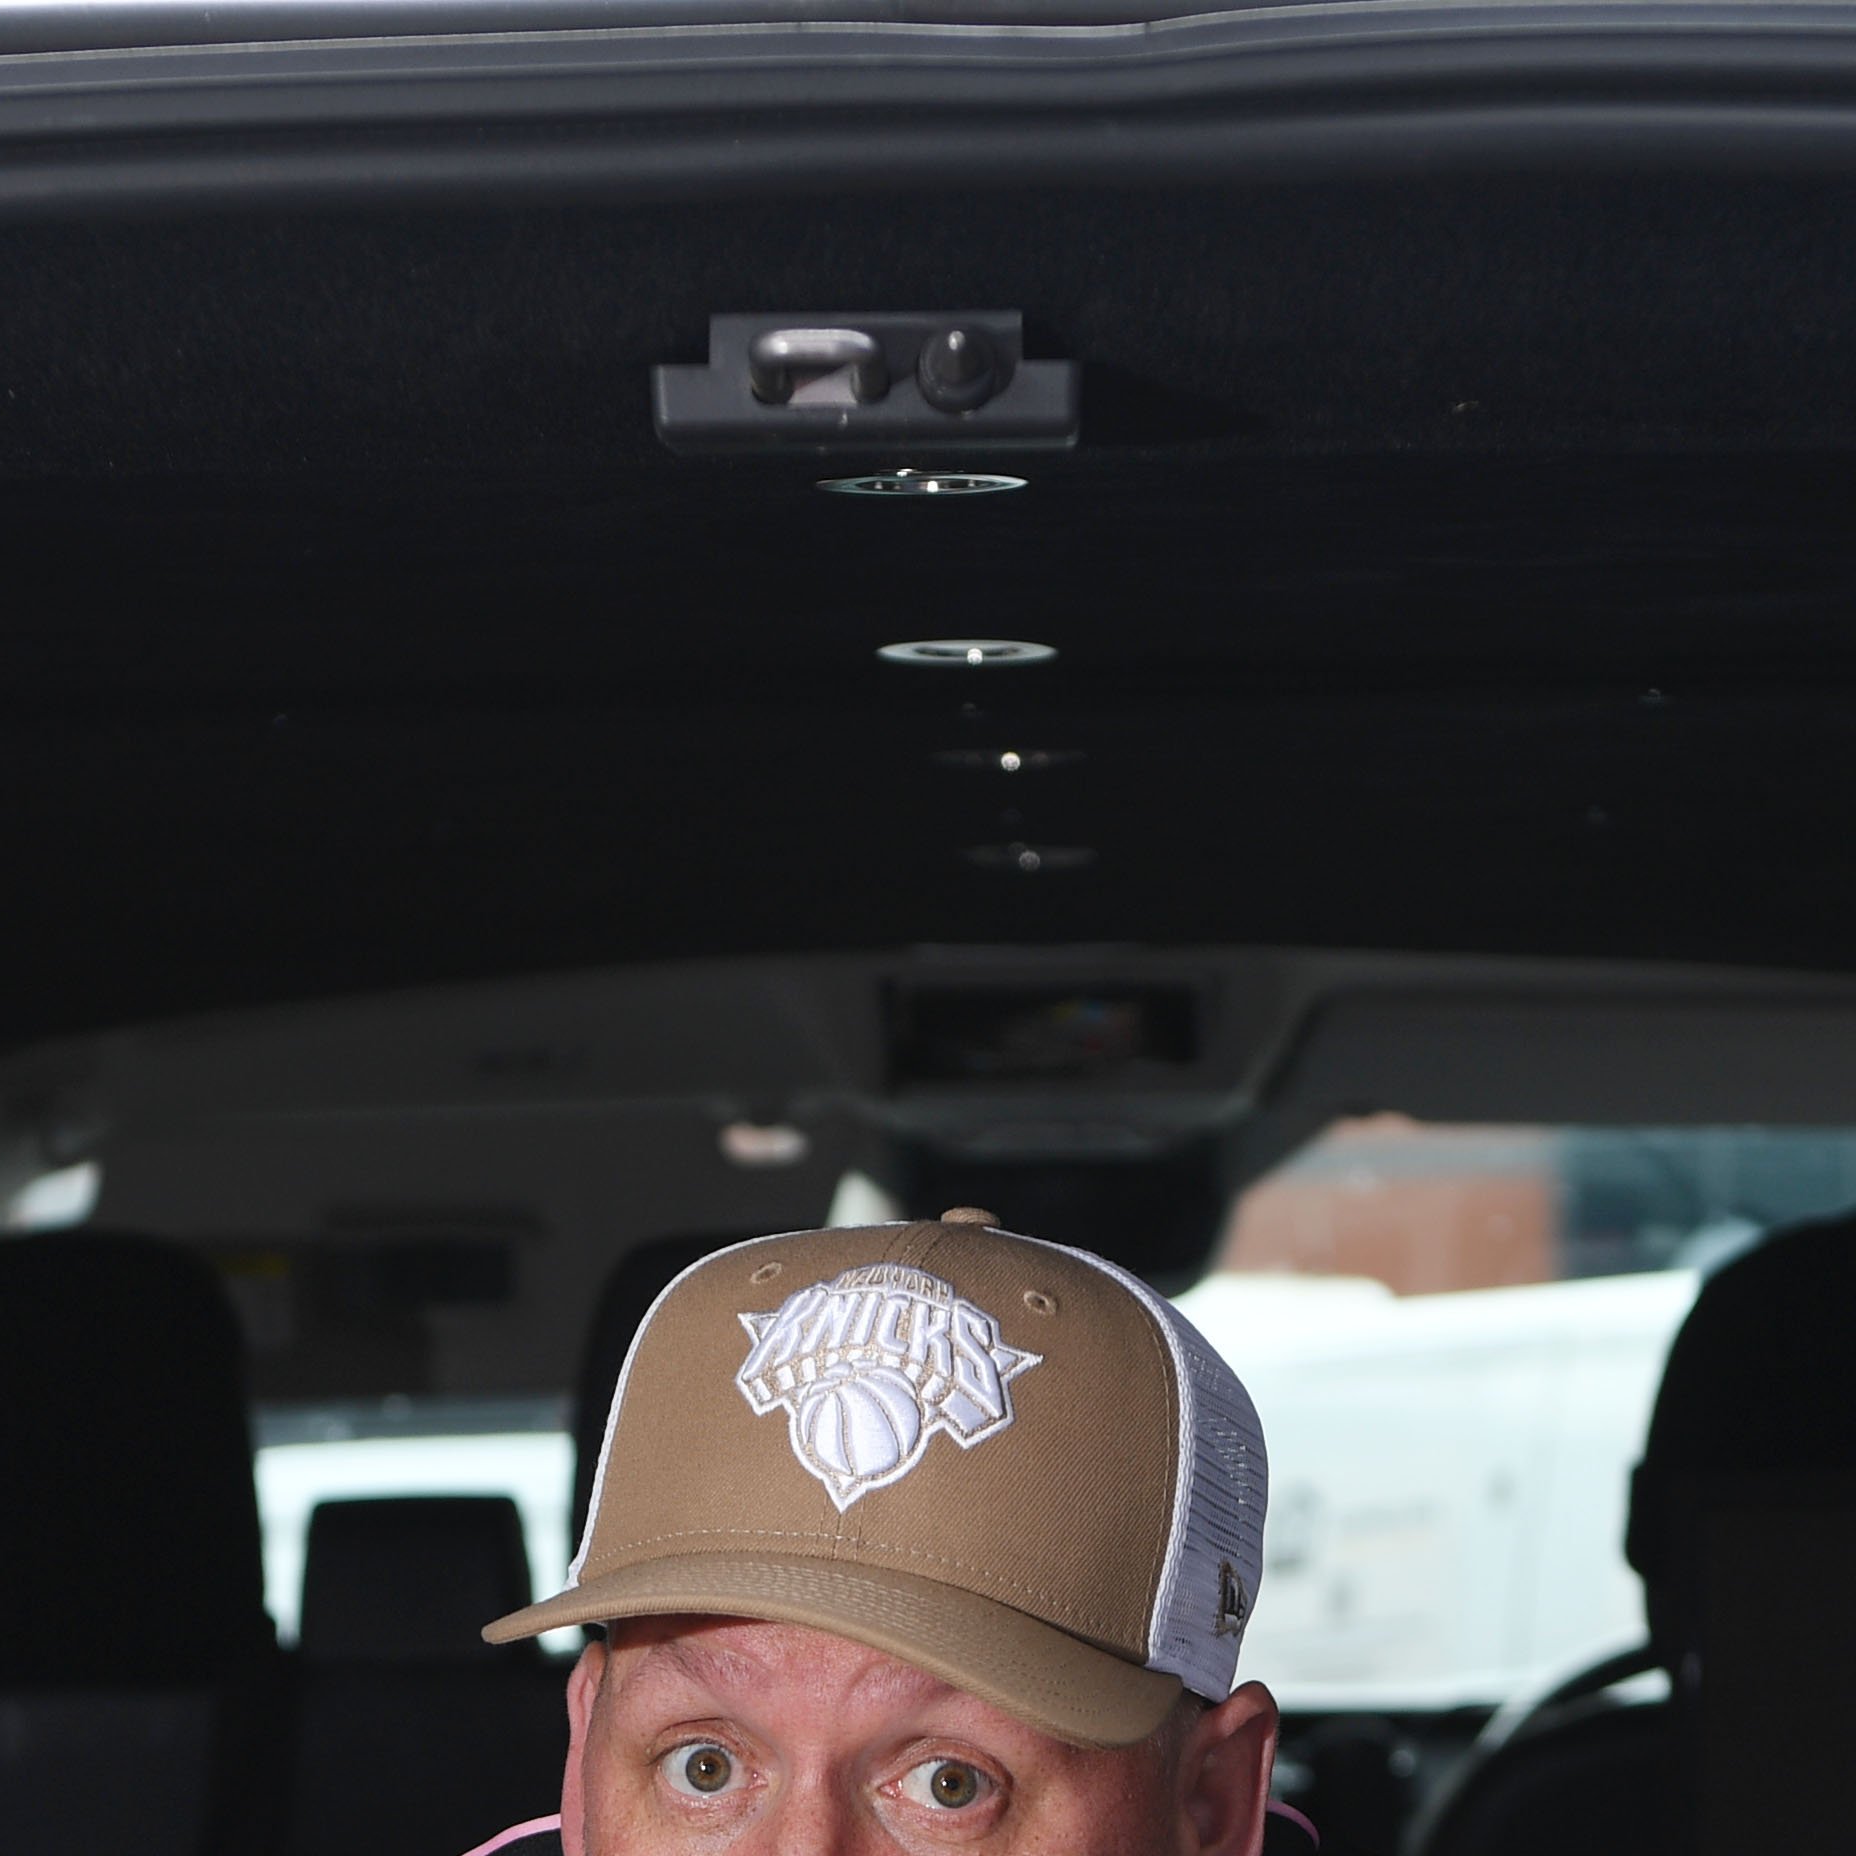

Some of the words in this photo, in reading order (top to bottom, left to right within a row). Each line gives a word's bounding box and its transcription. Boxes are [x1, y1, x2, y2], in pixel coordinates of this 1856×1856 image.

[835, 1265, 887, 1291] NEW
[889, 1265, 950, 1304] YORK
[742, 1288, 1005, 1418] KNICKS
